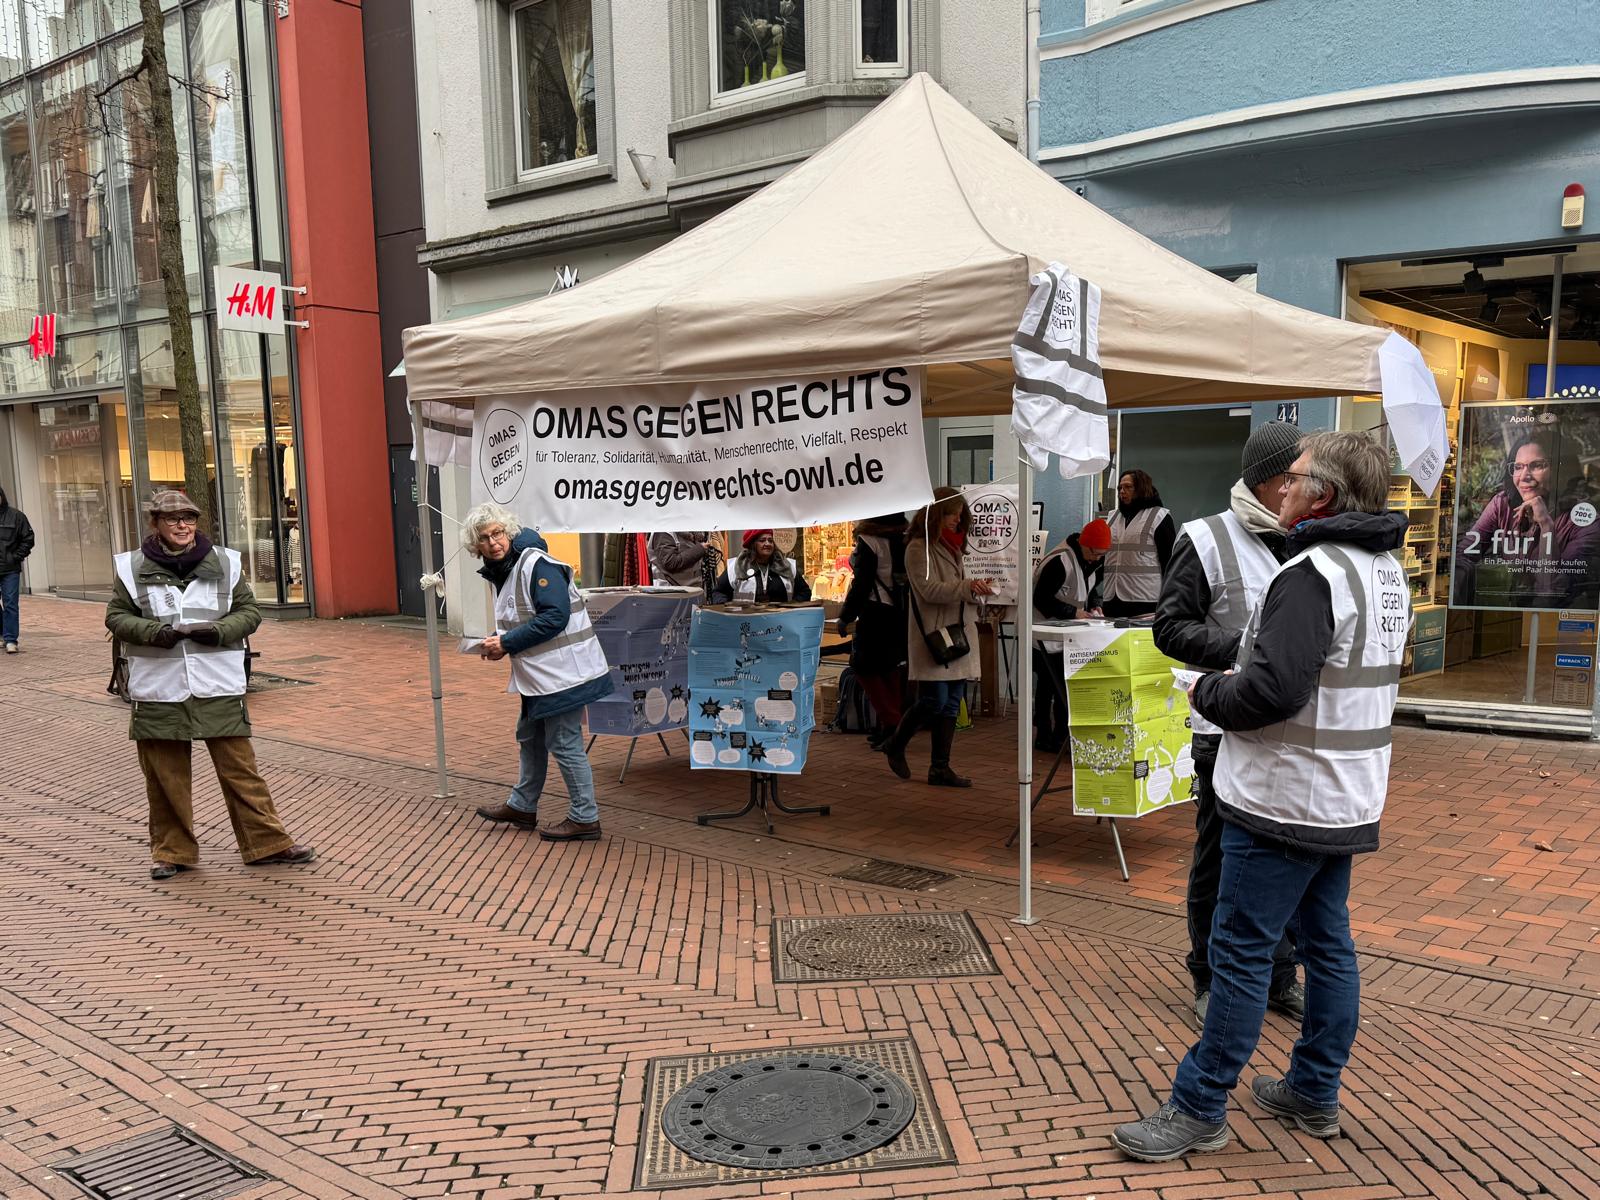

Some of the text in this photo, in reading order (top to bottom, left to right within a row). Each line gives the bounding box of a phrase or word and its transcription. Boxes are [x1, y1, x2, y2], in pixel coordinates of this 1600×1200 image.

[226, 282, 276, 321] H&M
[28, 313, 55, 361] H&M
[533, 366, 912, 439] OMAS GEGEN RECHTS
[1278, 406, 1298, 424] 44
[1510, 415, 1535, 424] Apollo
[488, 425, 517, 448] OMAS
[535, 421, 909, 465] für Toleranz, Solidarität, Humanität, Menschenrechte, Vielfalt, Respekt
[491, 442, 521, 469] GEGEN
[492, 460, 523, 489] RECHTS
[554, 452, 884, 507] omasgegenrechts-owl.de
[974, 502, 1010, 513] OMAS
[1575, 510, 1588, 518] 700
[972, 514, 1012, 526] GEGEN
[968, 526, 1012, 538] RECHTS
[988, 538, 1002, 546] OWL
[1463, 529, 1553, 555] 2 für 1
[1484, 557, 1495, 565] Ein
[1515, 558, 1559, 568] Brillengläser
[1560, 558, 1588, 567] kaufen,
[1544, 566, 1588, 574] bekommen.
[1377, 569, 1401, 587] OMAS
[1069, 649, 1119, 659] ANTISEMITISMUS
[1069, 657, 1102, 665] BEGEGNEN
